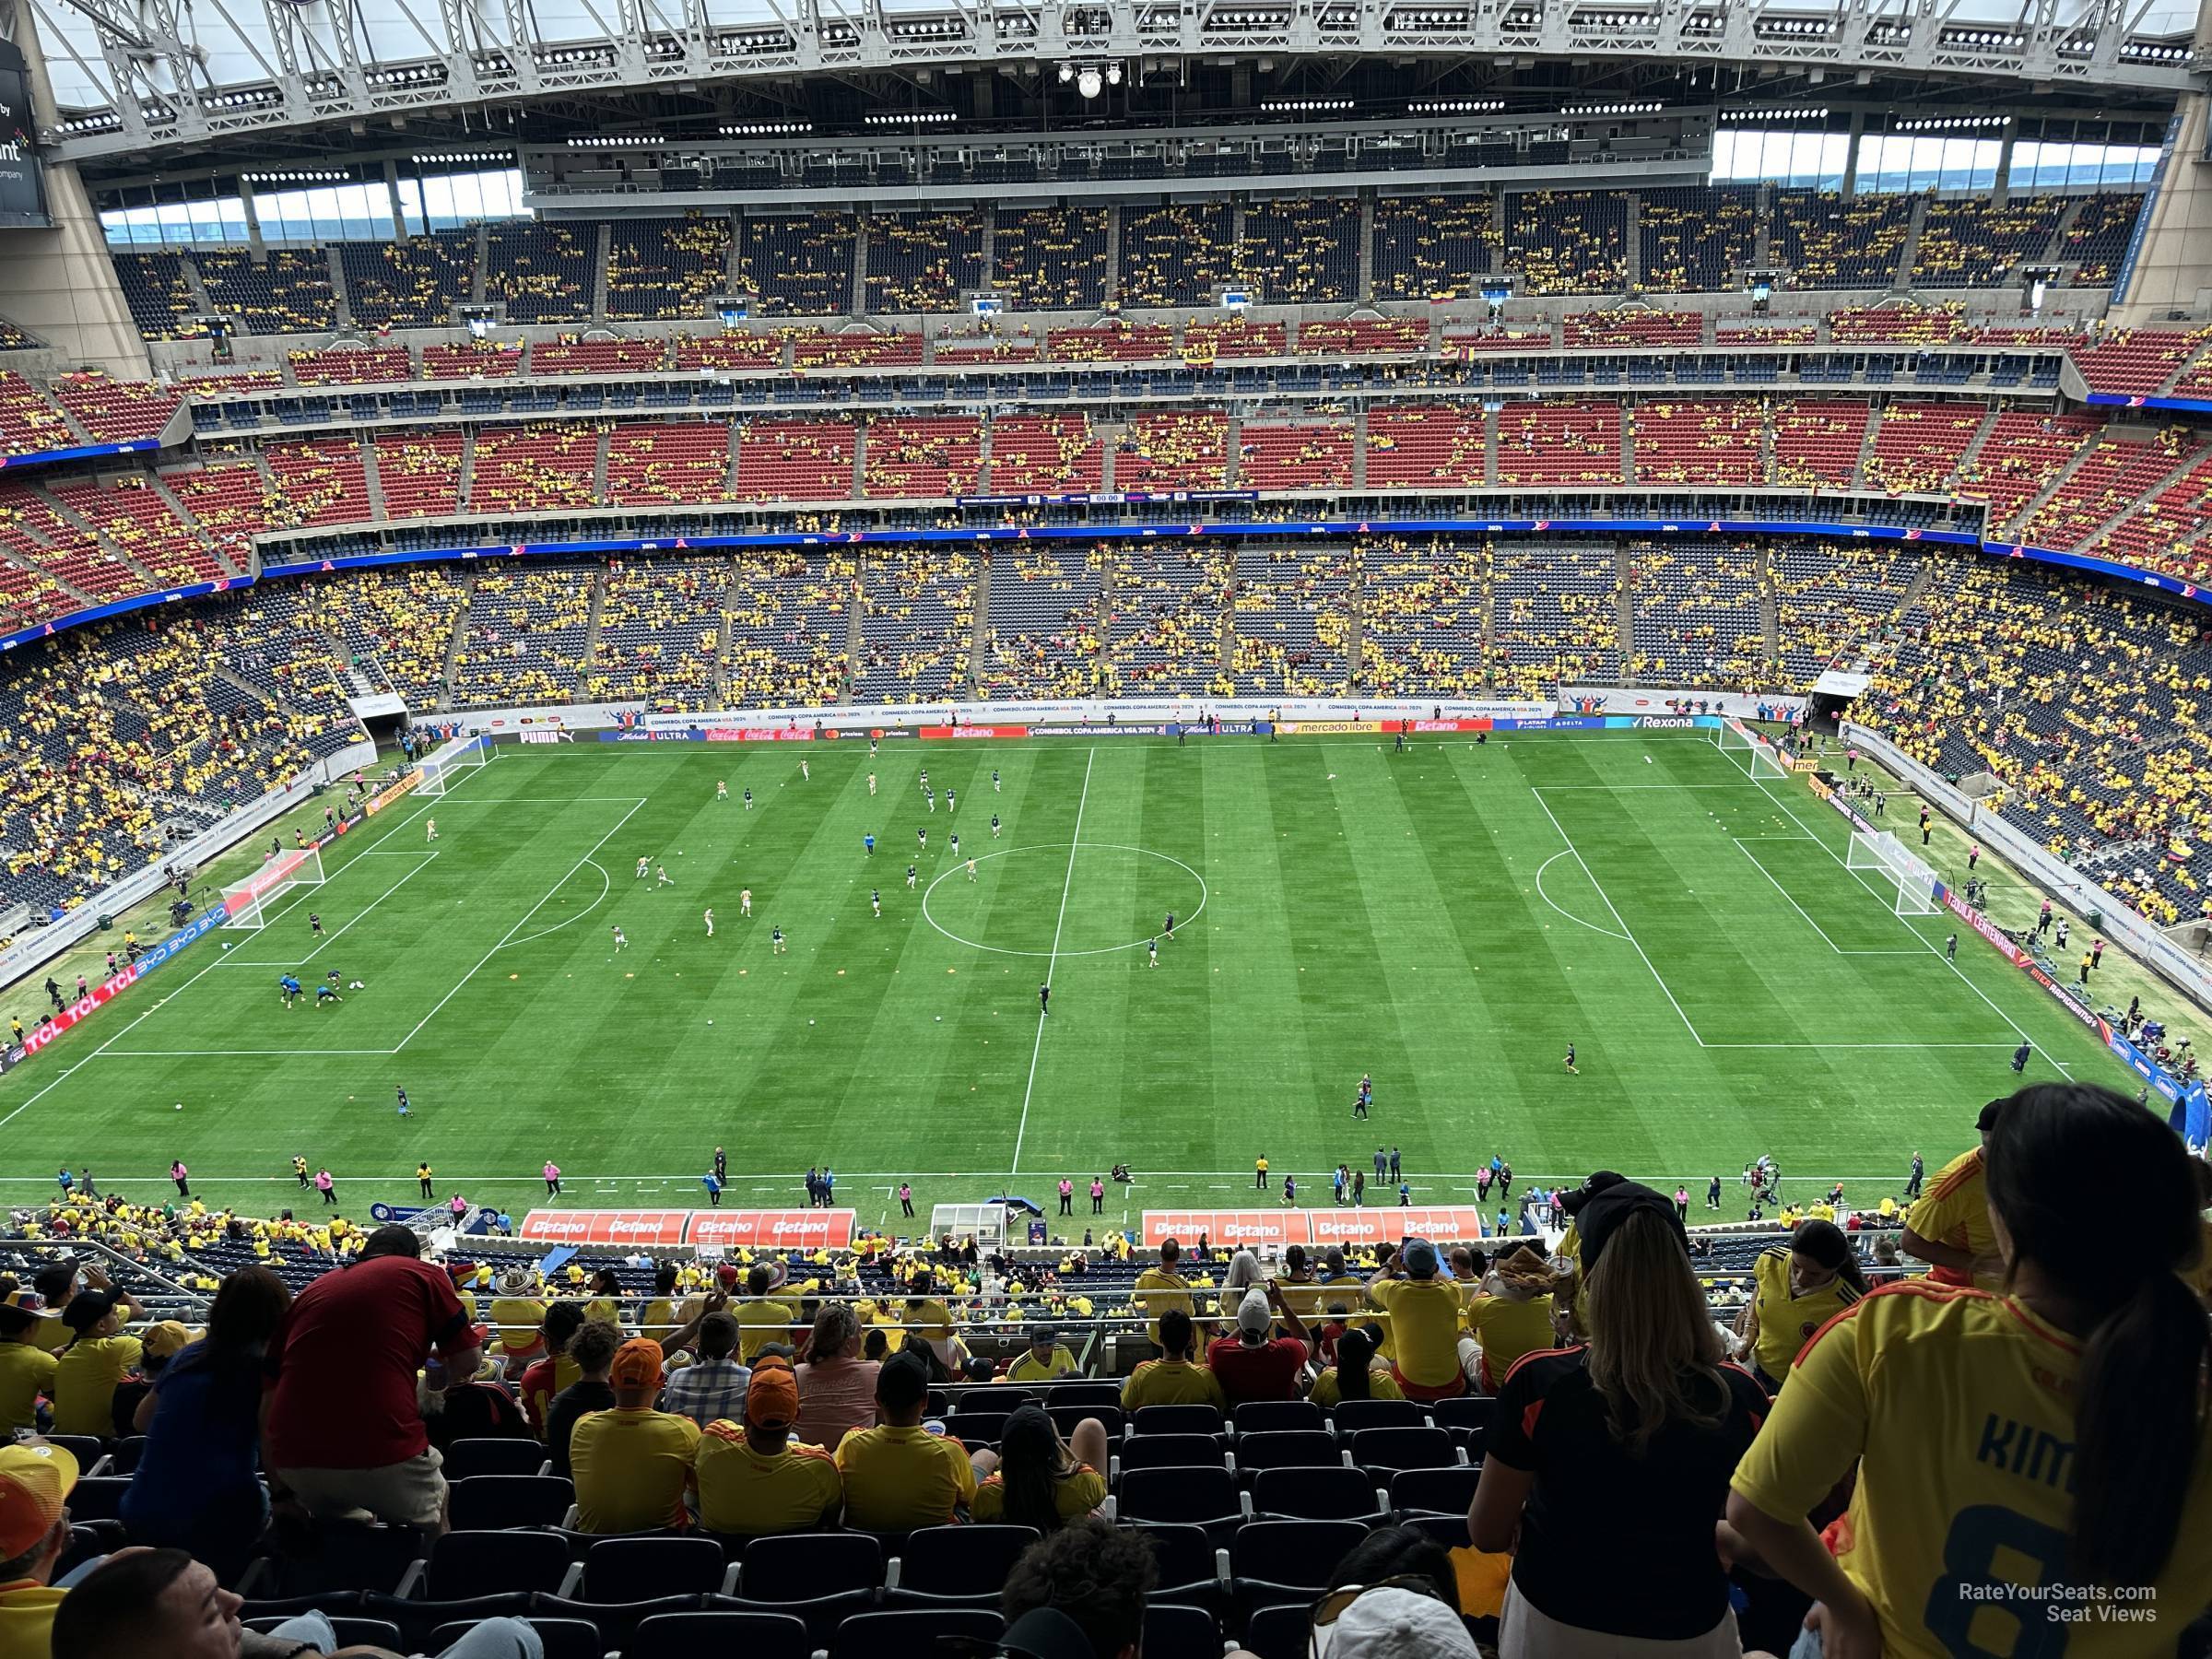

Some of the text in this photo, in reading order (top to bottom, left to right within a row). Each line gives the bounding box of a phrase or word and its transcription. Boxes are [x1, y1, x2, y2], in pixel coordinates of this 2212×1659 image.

[1221, 724, 1253, 733] ULTRA
[1301, 723, 1372, 731] mercado libre
[1416, 721, 1458, 731] Betano
[1643, 716, 1693, 728] Rexona
[519, 731, 559, 744] PUMA
[656, 732, 689, 740] ULTRA
[952, 727, 994, 737] Betano
[1034, 727, 1073, 735] CONMEBOL
[199, 907, 226, 929] BYD
[1947, 892, 2016, 959] TEQUILA CENTENARIO
[169, 927, 196, 952] BYD
[135, 948, 167, 975] BYD
[105, 971, 138, 997] TCL
[2030, 968, 2051, 988] INTER
[66, 994, 102, 1024] TCL
[25, 1018, 64, 1051] TCL
[530, 1221, 586, 1234] Betano
[609, 1220, 663, 1234] Betano
[697, 1221, 752, 1234] Betano
[772, 1220, 829, 1234] Betano
[1154, 1222, 1210, 1236] Betano
[1224, 1223, 1280, 1237] Betano
[1319, 1221, 1375, 1235] Betano
[1404, 1220, 1460, 1234] Betano
